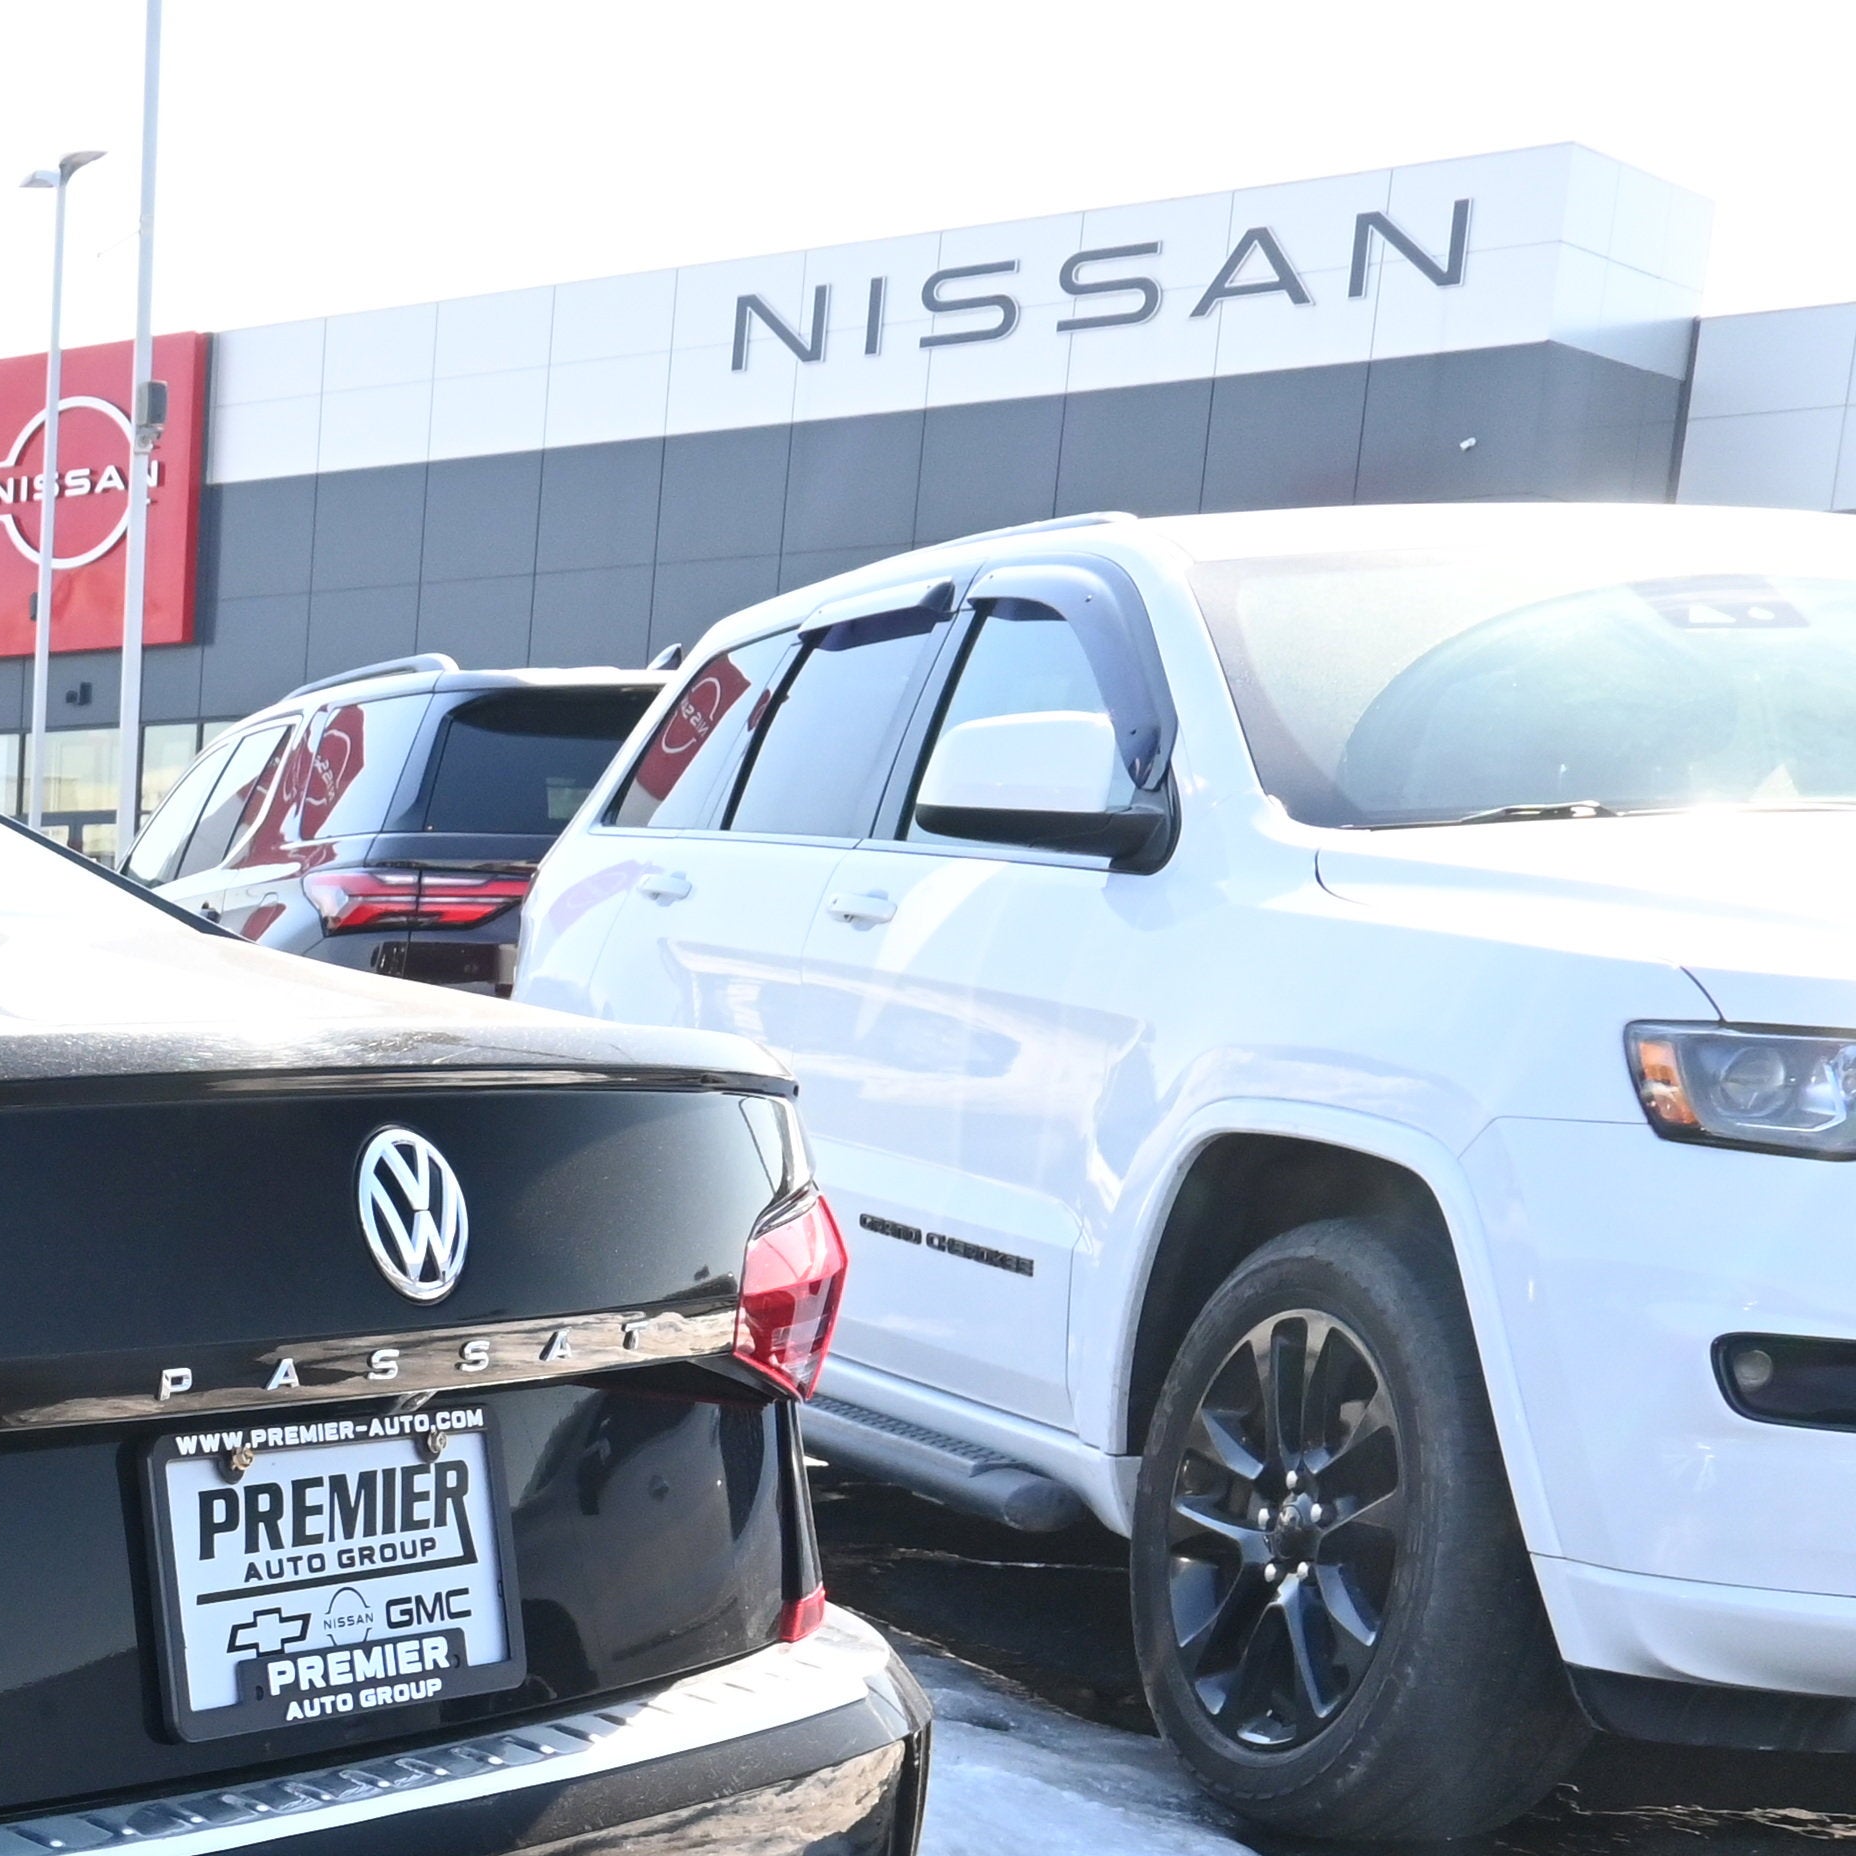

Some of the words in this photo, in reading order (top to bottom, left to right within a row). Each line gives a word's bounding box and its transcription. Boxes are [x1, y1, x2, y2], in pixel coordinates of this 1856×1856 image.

[731, 197, 1472, 373] NISSAN
[158, 1320, 649, 1401] PASSAT
[175, 1408, 484, 1456] WWW.PREMIER-AUTO.COM
[198, 1459, 476, 1562] PREMIER
[243, 1552, 326, 1583] AUTO
[337, 1536, 437, 1570] GROUP
[323, 1612, 374, 1630] NISSAN
[385, 1587, 472, 1629] GMC
[267, 1635, 450, 1697] PREMIER
[286, 1692, 354, 1721] AUTO
[359, 1678, 442, 1708] GROUP
